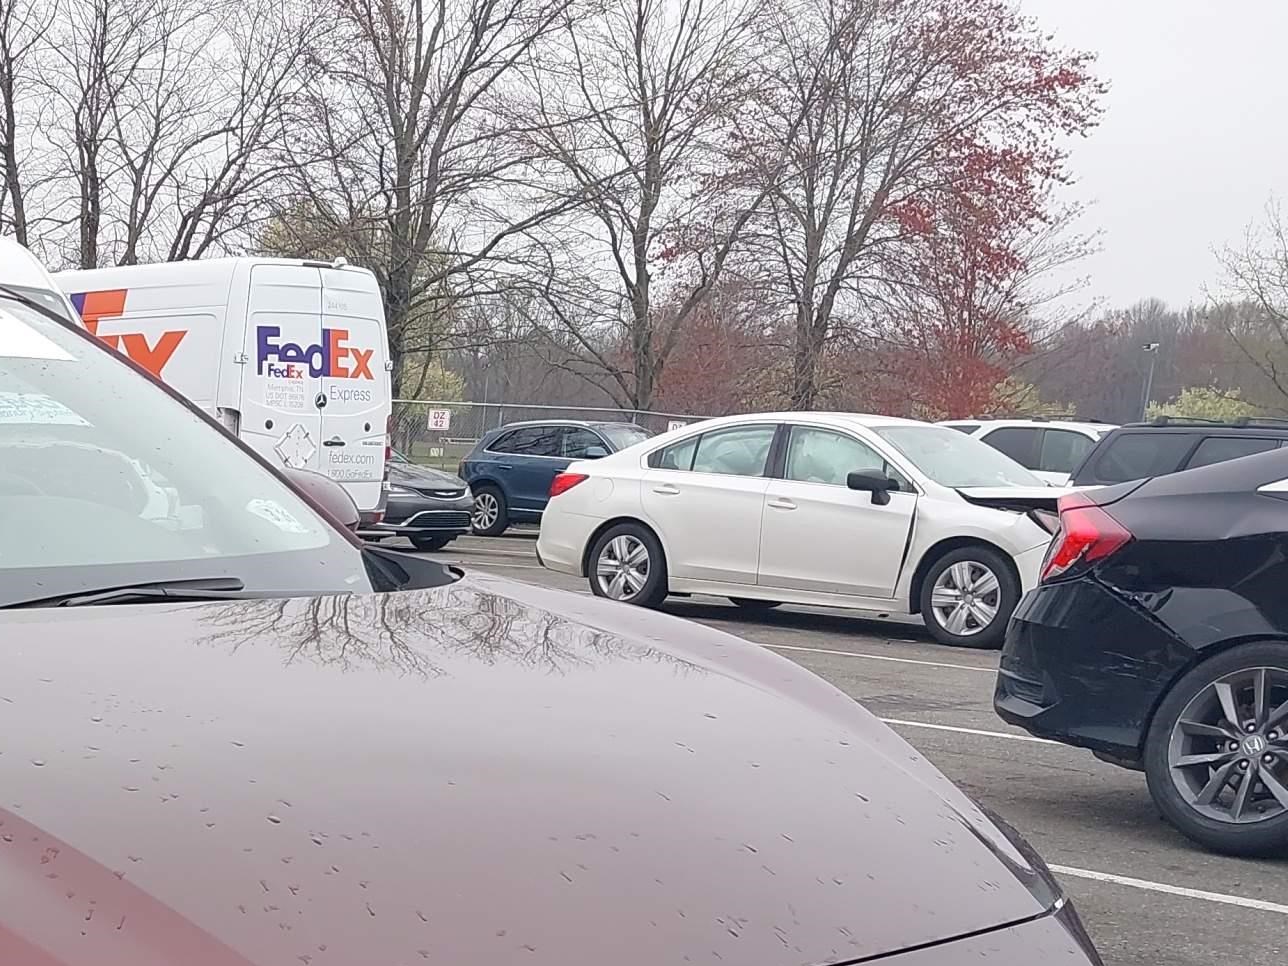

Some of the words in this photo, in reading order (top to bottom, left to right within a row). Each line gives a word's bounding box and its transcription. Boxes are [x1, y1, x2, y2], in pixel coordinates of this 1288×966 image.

[257, 326, 374, 379] FedEx
[268, 364, 303, 378] FedEx
[330, 386, 371, 403] Express
[328, 450, 375, 466] fedex.com
